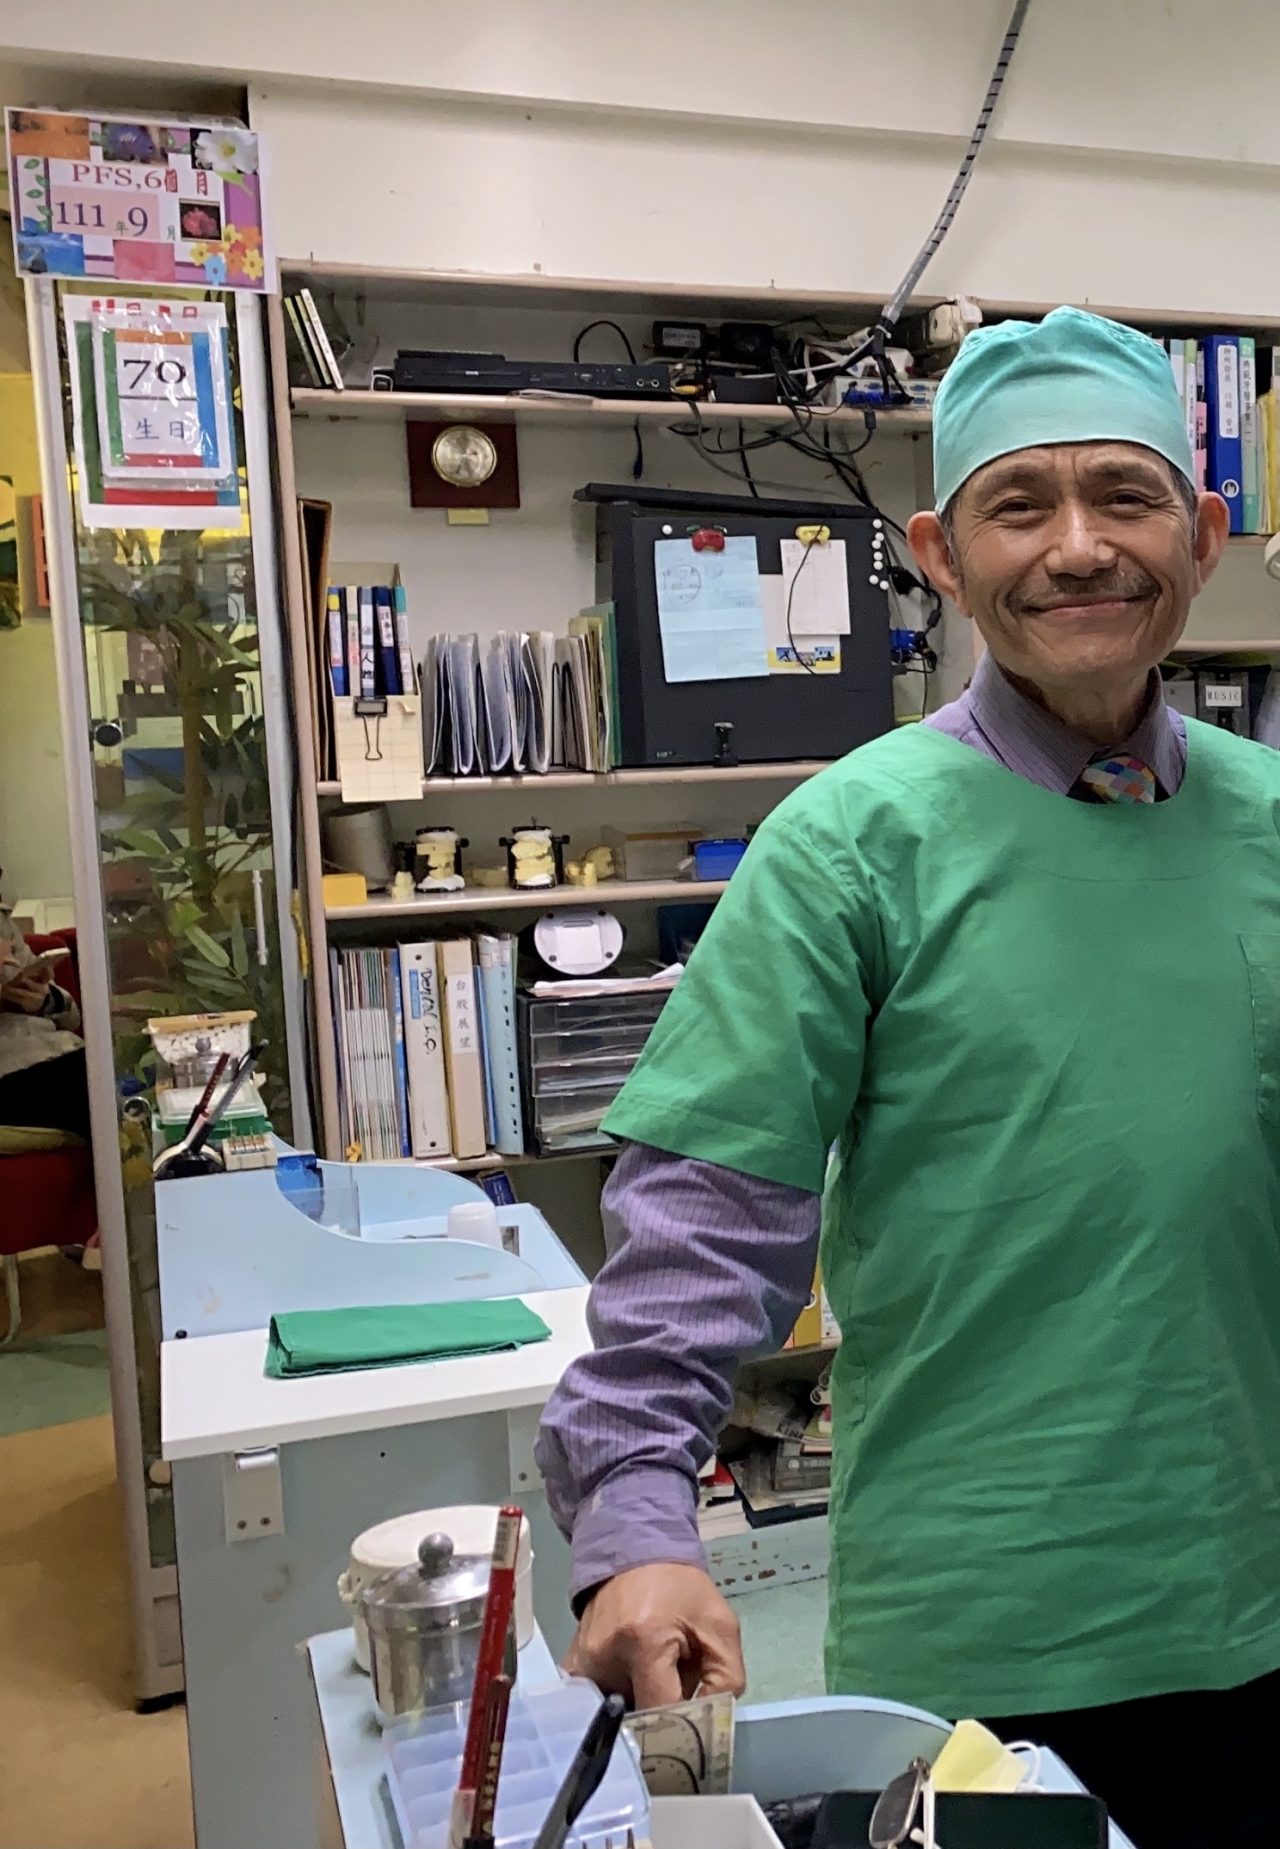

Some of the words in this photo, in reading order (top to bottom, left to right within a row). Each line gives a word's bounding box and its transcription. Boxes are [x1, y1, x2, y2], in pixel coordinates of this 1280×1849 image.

[123, 359, 187, 390] 70
[135, 418, 184, 440] 生日
[1207, 690, 1240, 701] MUSIC
